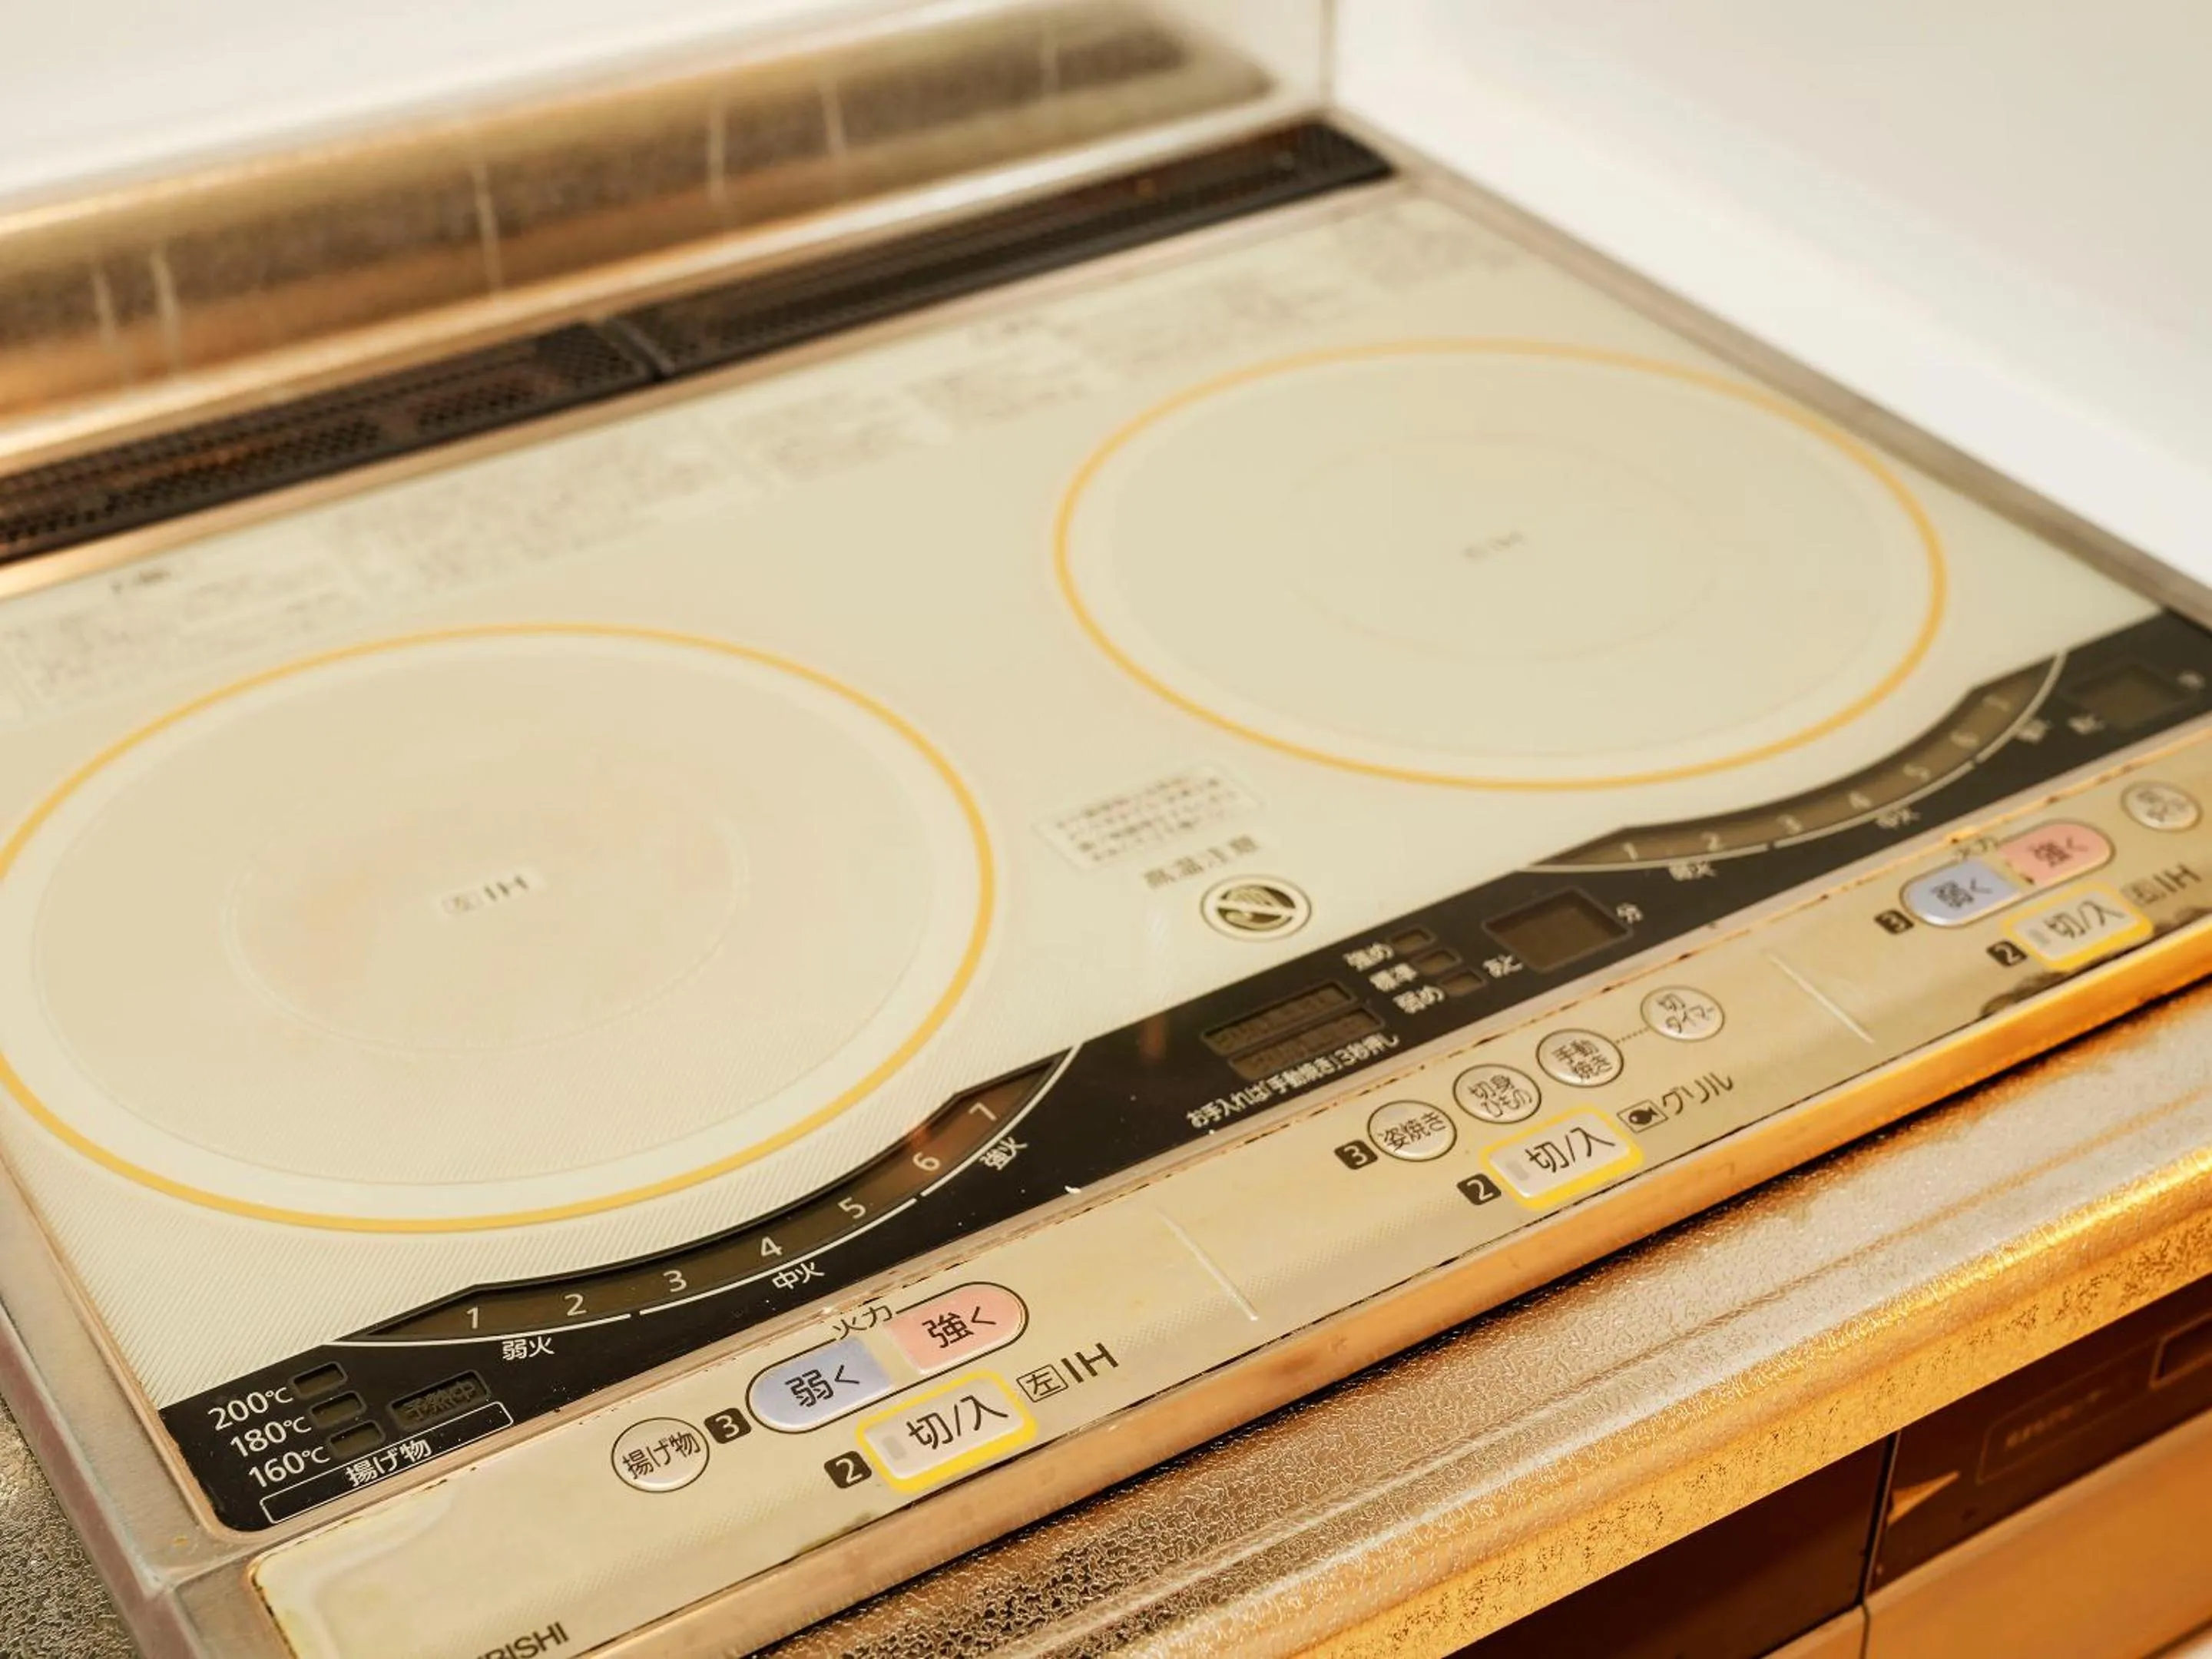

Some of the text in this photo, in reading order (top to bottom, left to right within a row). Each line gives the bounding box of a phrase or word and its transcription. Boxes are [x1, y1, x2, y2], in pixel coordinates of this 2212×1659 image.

[1998, 944, 2020, 963] 2
[1657, 994, 1686, 1011] 切
[1469, 1075, 1515, 1100] 切身
[1481, 1090, 1533, 1118] ひもの
[1662, 1073, 1733, 1116] グリル
[1378, 1111, 1447, 1152] 姿焼き
[980, 1137, 1028, 1171] 強火
[1345, 1144, 1367, 1165] 3
[1525, 1127, 1616, 1174] 切/入
[1469, 1176, 1494, 1202] 2
[466, 1103, 996, 1329] 1 2 3 4 5 6 7
[772, 1261, 825, 1291] 中火
[833, 1303, 893, 1340] 火力
[921, 1306, 997, 1349] 強く
[502, 1336, 555, 1360] 弱火
[786, 1364, 860, 1407] 弱く
[717, 1414, 742, 1439] 3
[907, 1393, 1008, 1451] 切/入
[346, 1439, 432, 1487] 揚げ物
[621, 1429, 701, 1481] 揚げ物
[838, 1455, 863, 1483] 2
